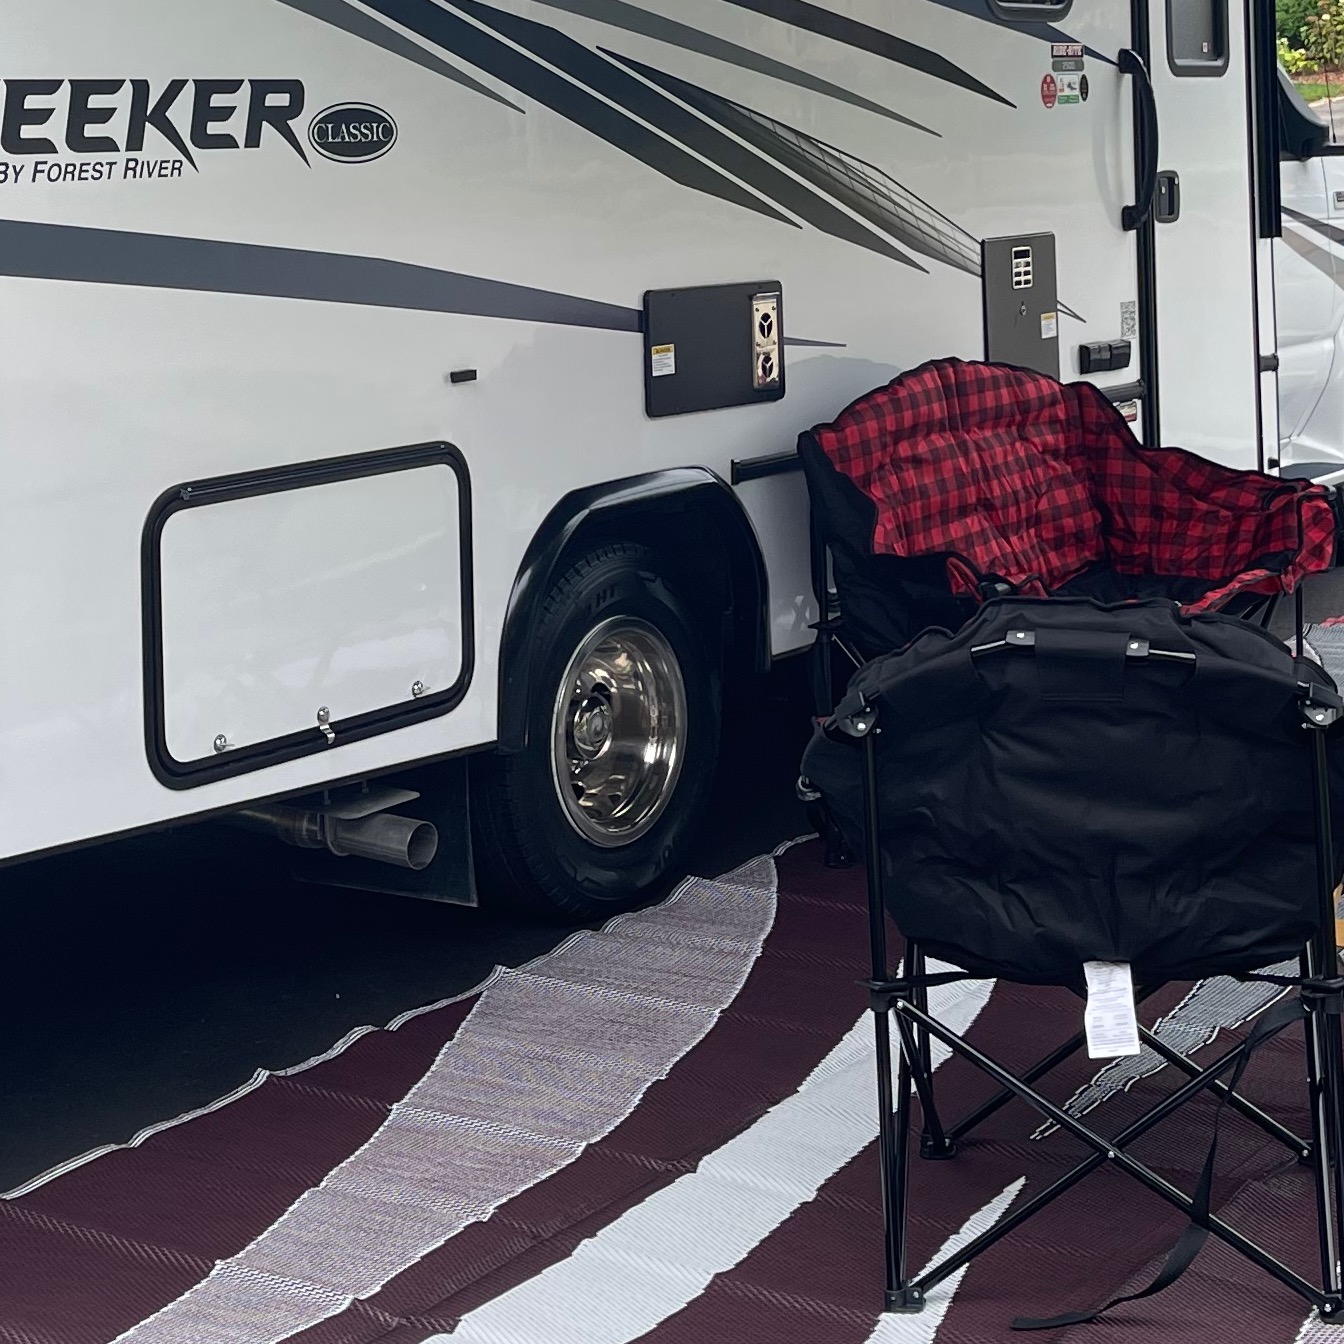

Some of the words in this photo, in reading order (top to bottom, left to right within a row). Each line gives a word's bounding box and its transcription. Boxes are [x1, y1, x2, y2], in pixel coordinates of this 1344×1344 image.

[313, 121, 392, 144] CLASSIC
[31, 160, 118, 183] FOREST
[123, 157, 184, 180] RIVER
